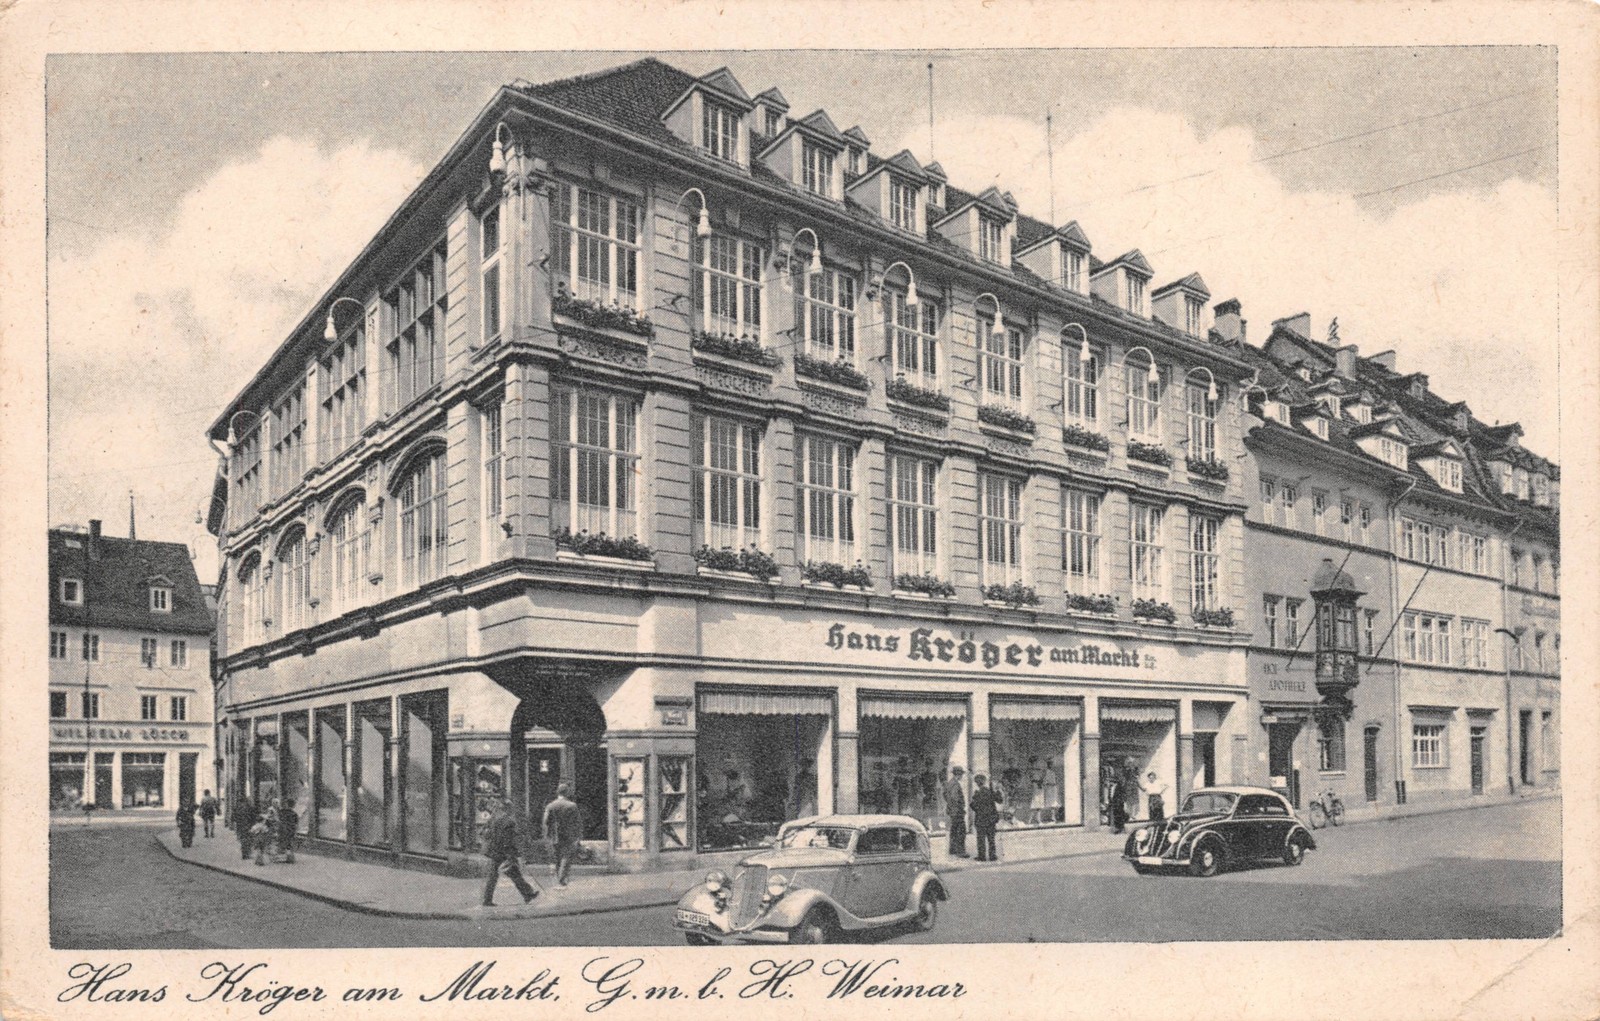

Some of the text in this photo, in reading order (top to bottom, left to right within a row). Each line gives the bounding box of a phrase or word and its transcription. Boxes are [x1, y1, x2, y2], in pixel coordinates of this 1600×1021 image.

[825, 622, 900, 652] Hans
[907, 626, 1043, 669] Kröger
[1049, 647, 1079, 663] am
